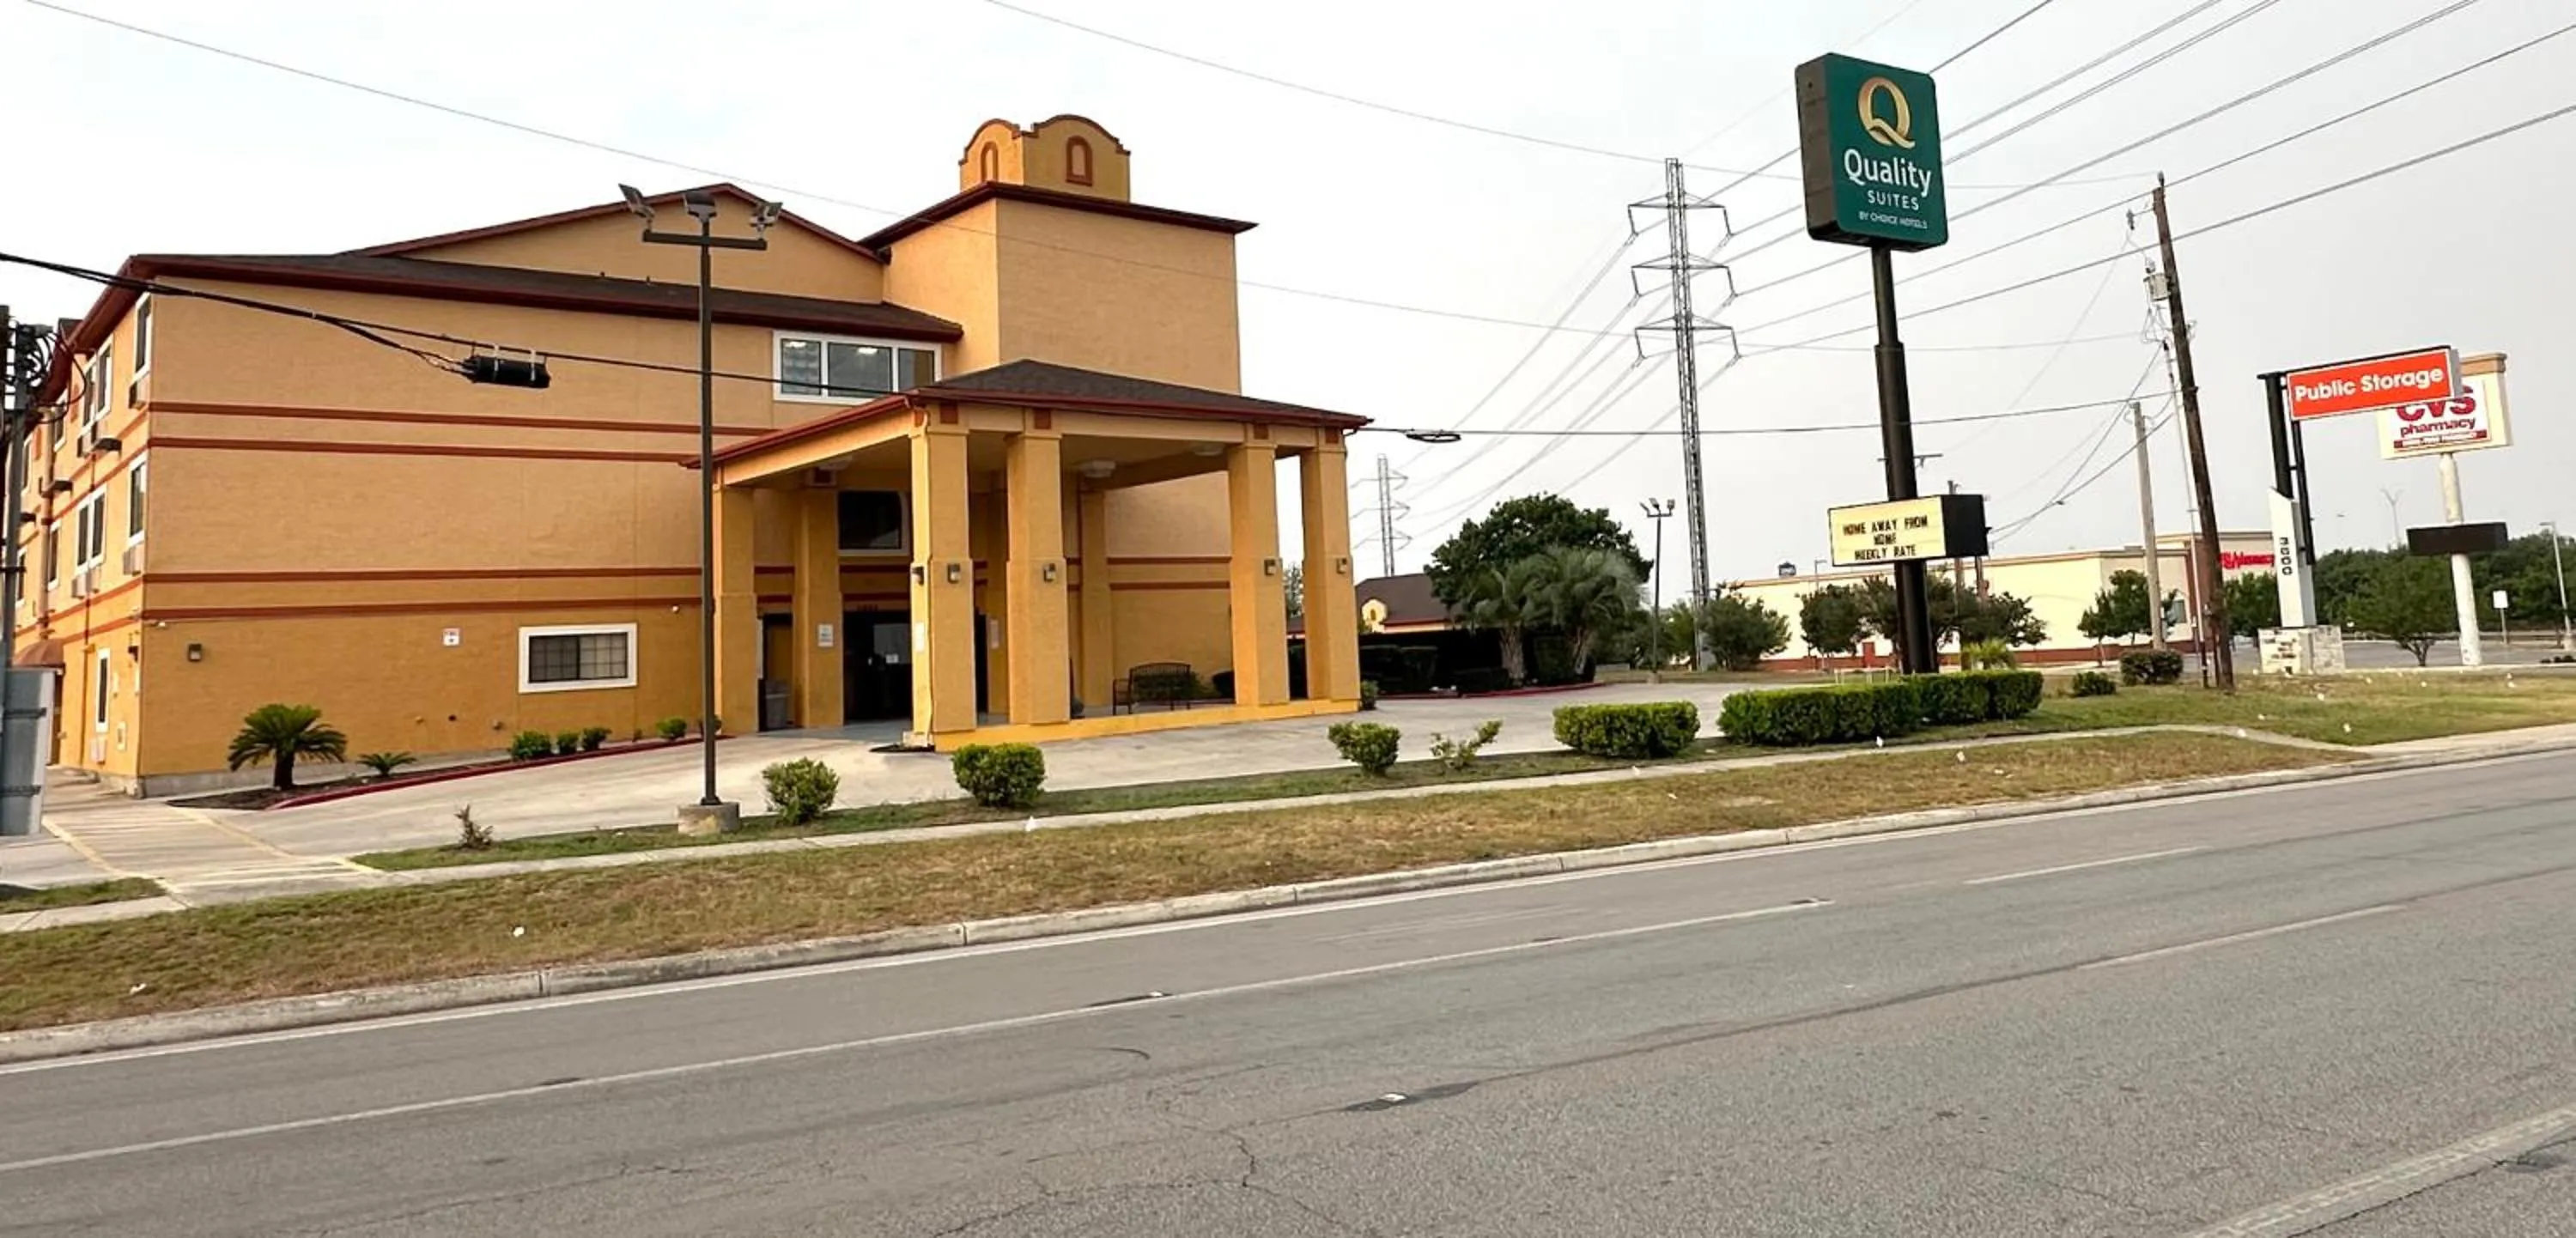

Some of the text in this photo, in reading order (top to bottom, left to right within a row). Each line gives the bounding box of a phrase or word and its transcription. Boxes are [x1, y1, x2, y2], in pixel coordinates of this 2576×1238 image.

[1844, 149, 1931, 197] Quality
[1868, 190, 1919, 210] SUITES
[2293, 367, 2444, 402] Public Storage
[2400, 417, 2476, 438] pharmacy
[1844, 515, 1928, 536] HOME AWAY FROM
[1874, 532, 1896, 545] HOME
[1855, 544, 1916, 560] WEEKLY RATE
